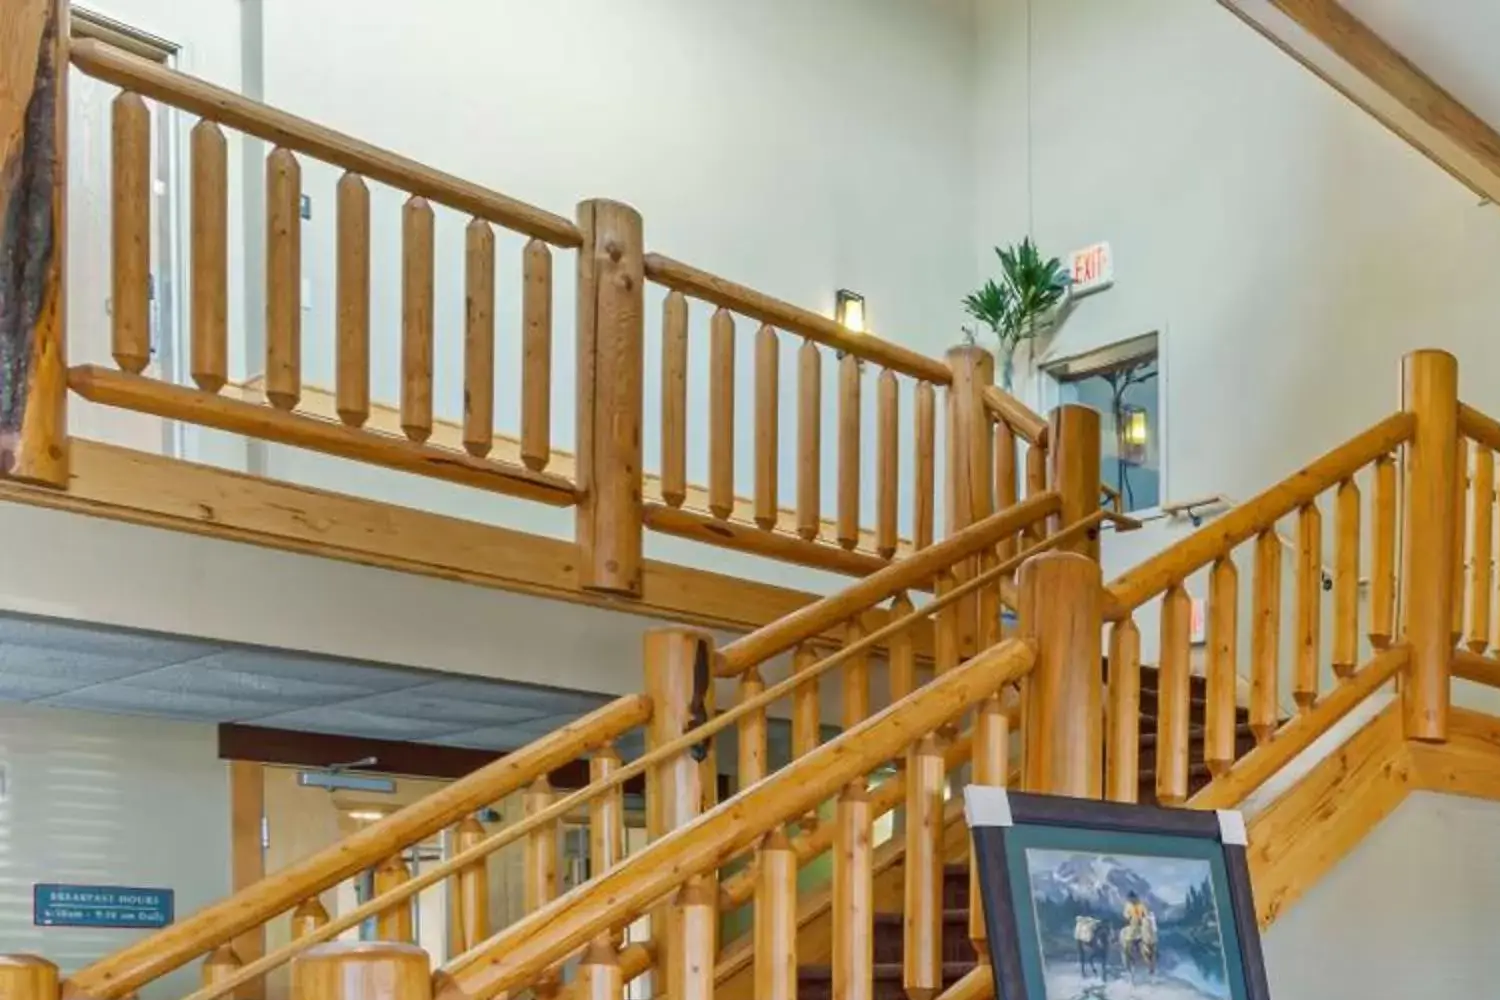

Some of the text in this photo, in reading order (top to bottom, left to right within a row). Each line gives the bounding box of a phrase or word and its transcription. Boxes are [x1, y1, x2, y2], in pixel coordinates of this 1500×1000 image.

[1074, 247, 1103, 284] EXIT
[50, 891, 160, 906] BREAKFAST HOURS
